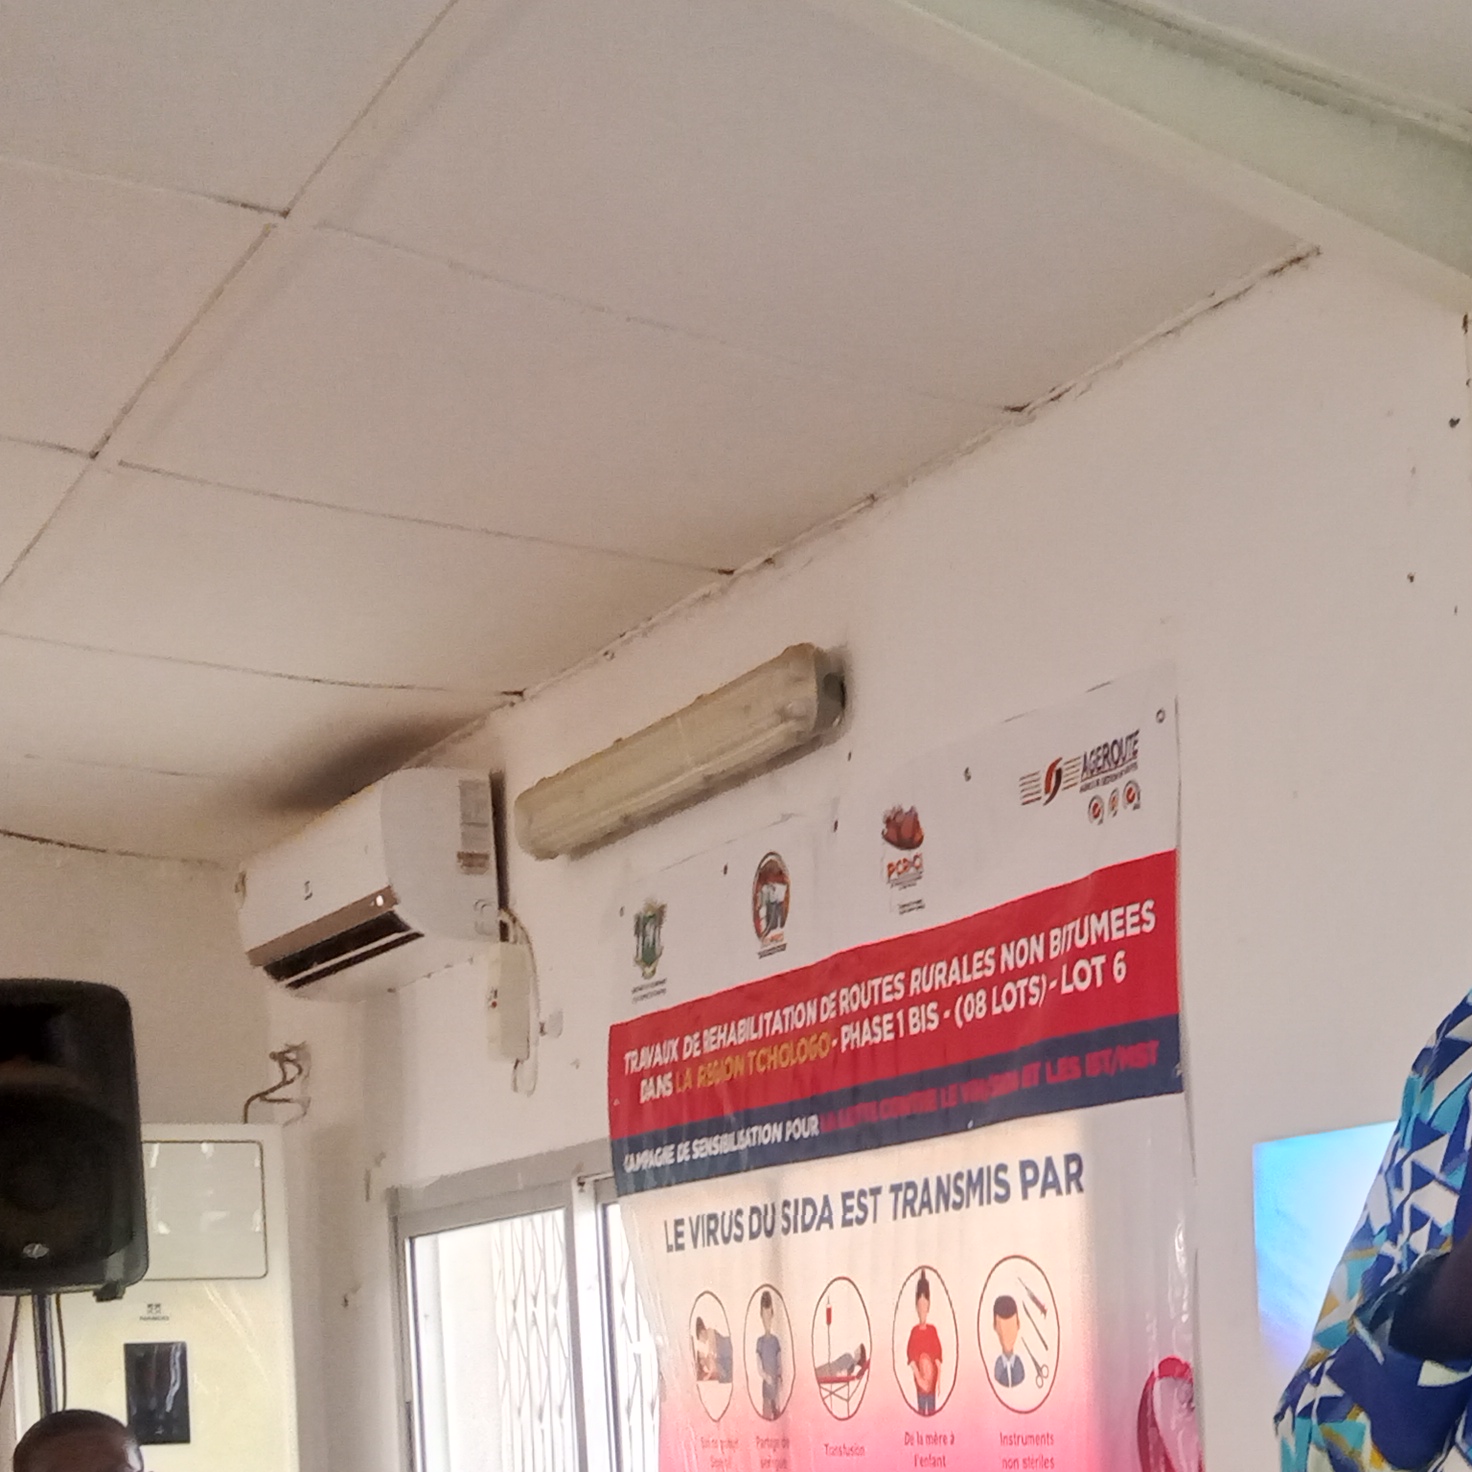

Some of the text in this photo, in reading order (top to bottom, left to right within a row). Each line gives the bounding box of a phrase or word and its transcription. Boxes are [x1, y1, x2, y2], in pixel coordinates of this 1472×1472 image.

[1080, 728, 1140, 782] AGEROUTE
[623, 898, 1157, 1076] TRAVAUX DE REHABILITATION DE ROUTES RURALES NON BITUMEES
[639, 1071, 674, 1104] DANS
[675, 1067, 694, 1093] LA
[746, 1030, 832, 1074] TCHOLOGO
[840, 1012, 896, 1053] PHASE
[897, 1011, 905, 1038] 1
[908, 1001, 940, 1036] BIS
[954, 989, 988, 1029] (08
[1060, 952, 1108, 995] LOT
[1112, 949, 1128, 985] 6
[677, 1139, 691, 1164] DE
[784, 1113, 820, 1142] POUR
[1045, 1055, 1082, 1084] LES
[663, 1151, 1085, 1253] LE VIRUS DU SIDA EST TRANSMIS PAR
[823, 1442, 866, 1457] Transfusion
[904, 1431, 915, 1446] De
[916, 1431, 924, 1445] la
[925, 1431, 948, 1446] mère
[999, 1431, 1055, 1447] Instruments
[914, 1453, 1055, 1470] l'enfant non stériles
